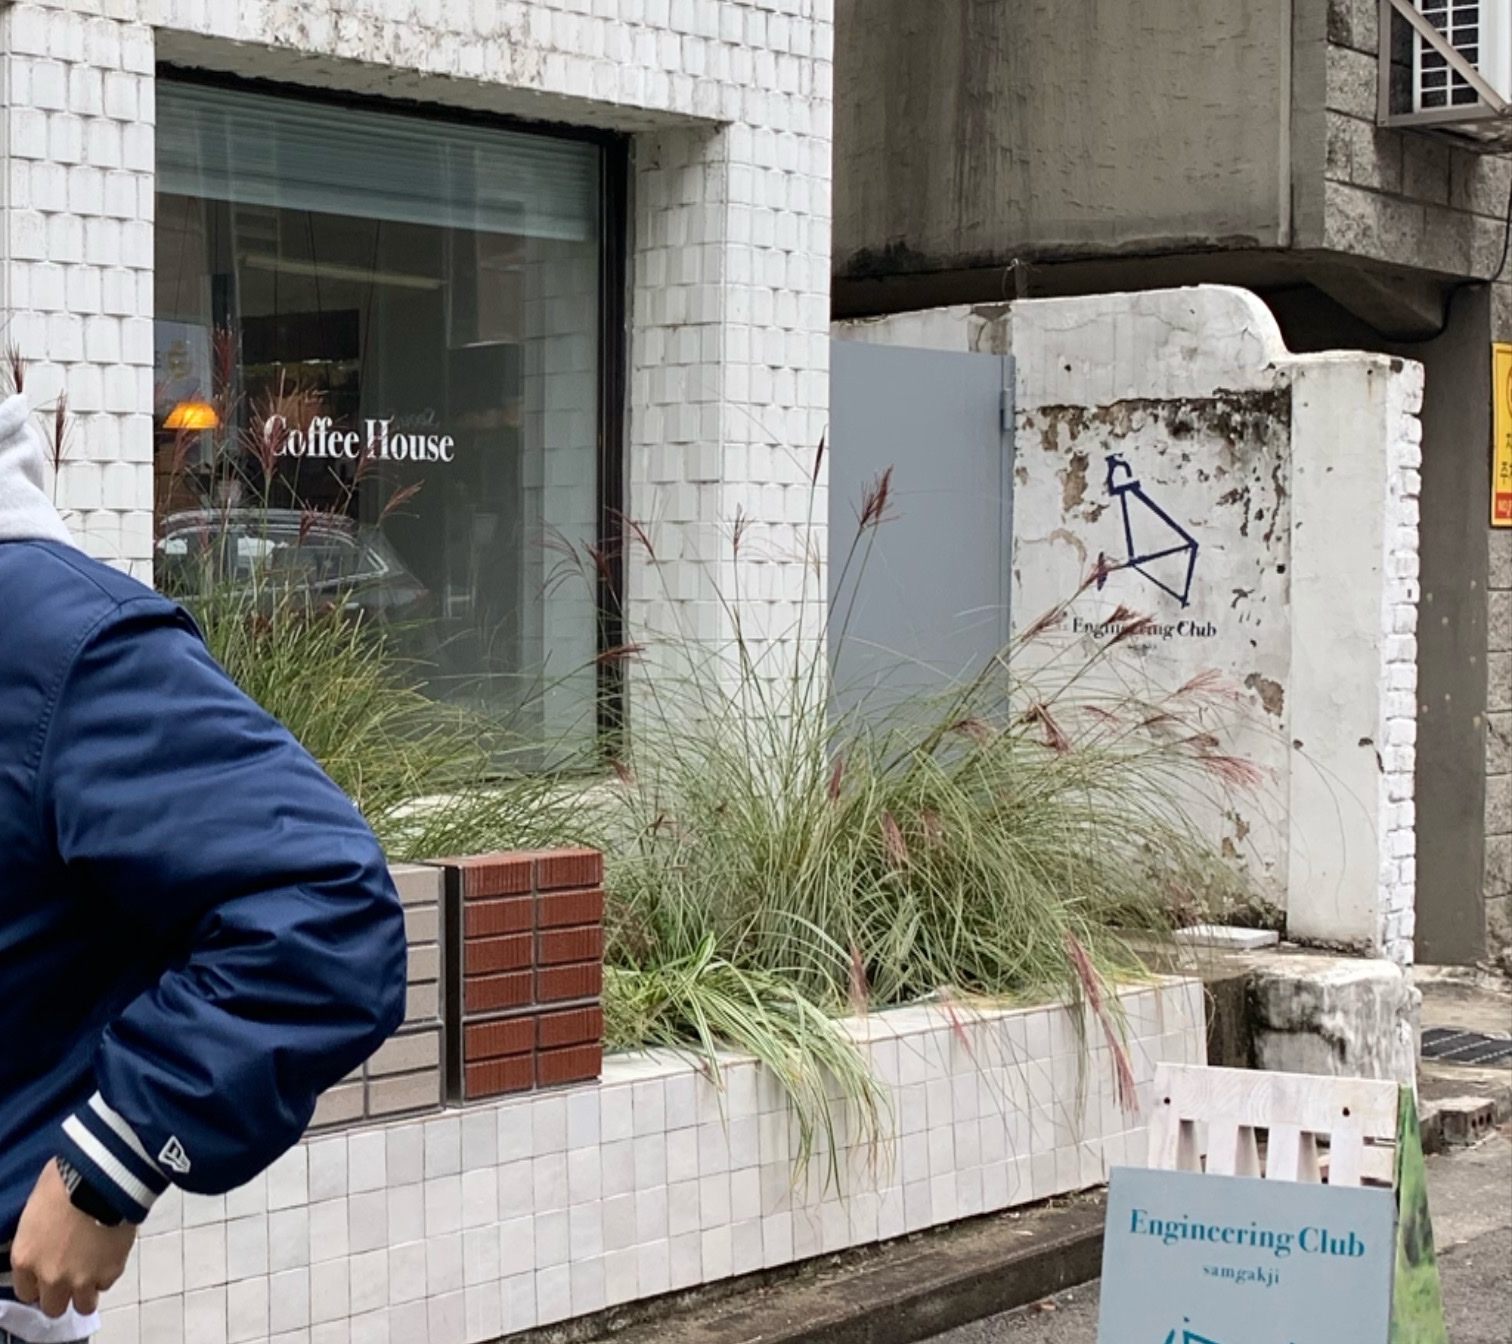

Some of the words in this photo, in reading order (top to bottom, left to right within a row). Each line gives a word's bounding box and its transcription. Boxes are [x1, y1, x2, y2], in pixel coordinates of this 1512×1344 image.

[263, 413, 360, 458] Coffee
[364, 418, 455, 463] House
[1177, 620, 1217, 637] Club
[1129, 1208, 1295, 1260] Engineering
[1298, 1226, 1366, 1258] Club
[1202, 1264, 1280, 1288] samgakji
